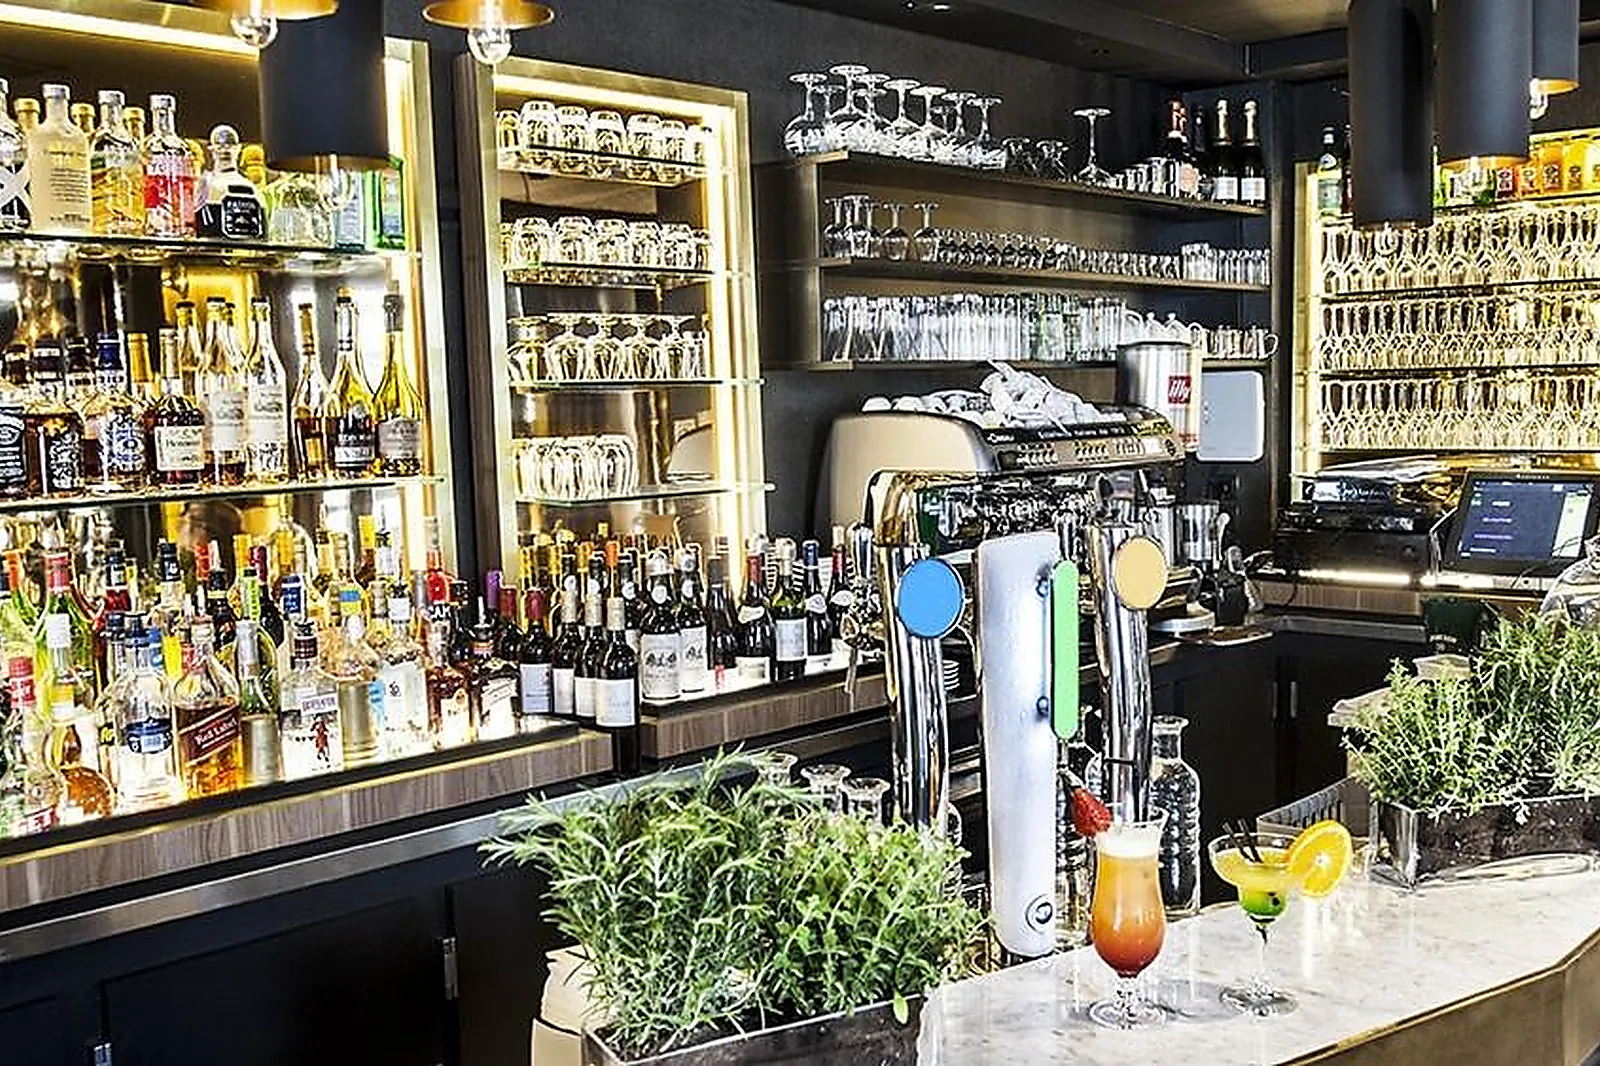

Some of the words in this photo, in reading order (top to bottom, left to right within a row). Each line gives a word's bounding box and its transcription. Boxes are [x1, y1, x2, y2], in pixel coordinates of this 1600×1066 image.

[1168, 379, 1190, 402] illy
[194, 730, 214, 745] Red
[213, 717, 238, 735] Label
